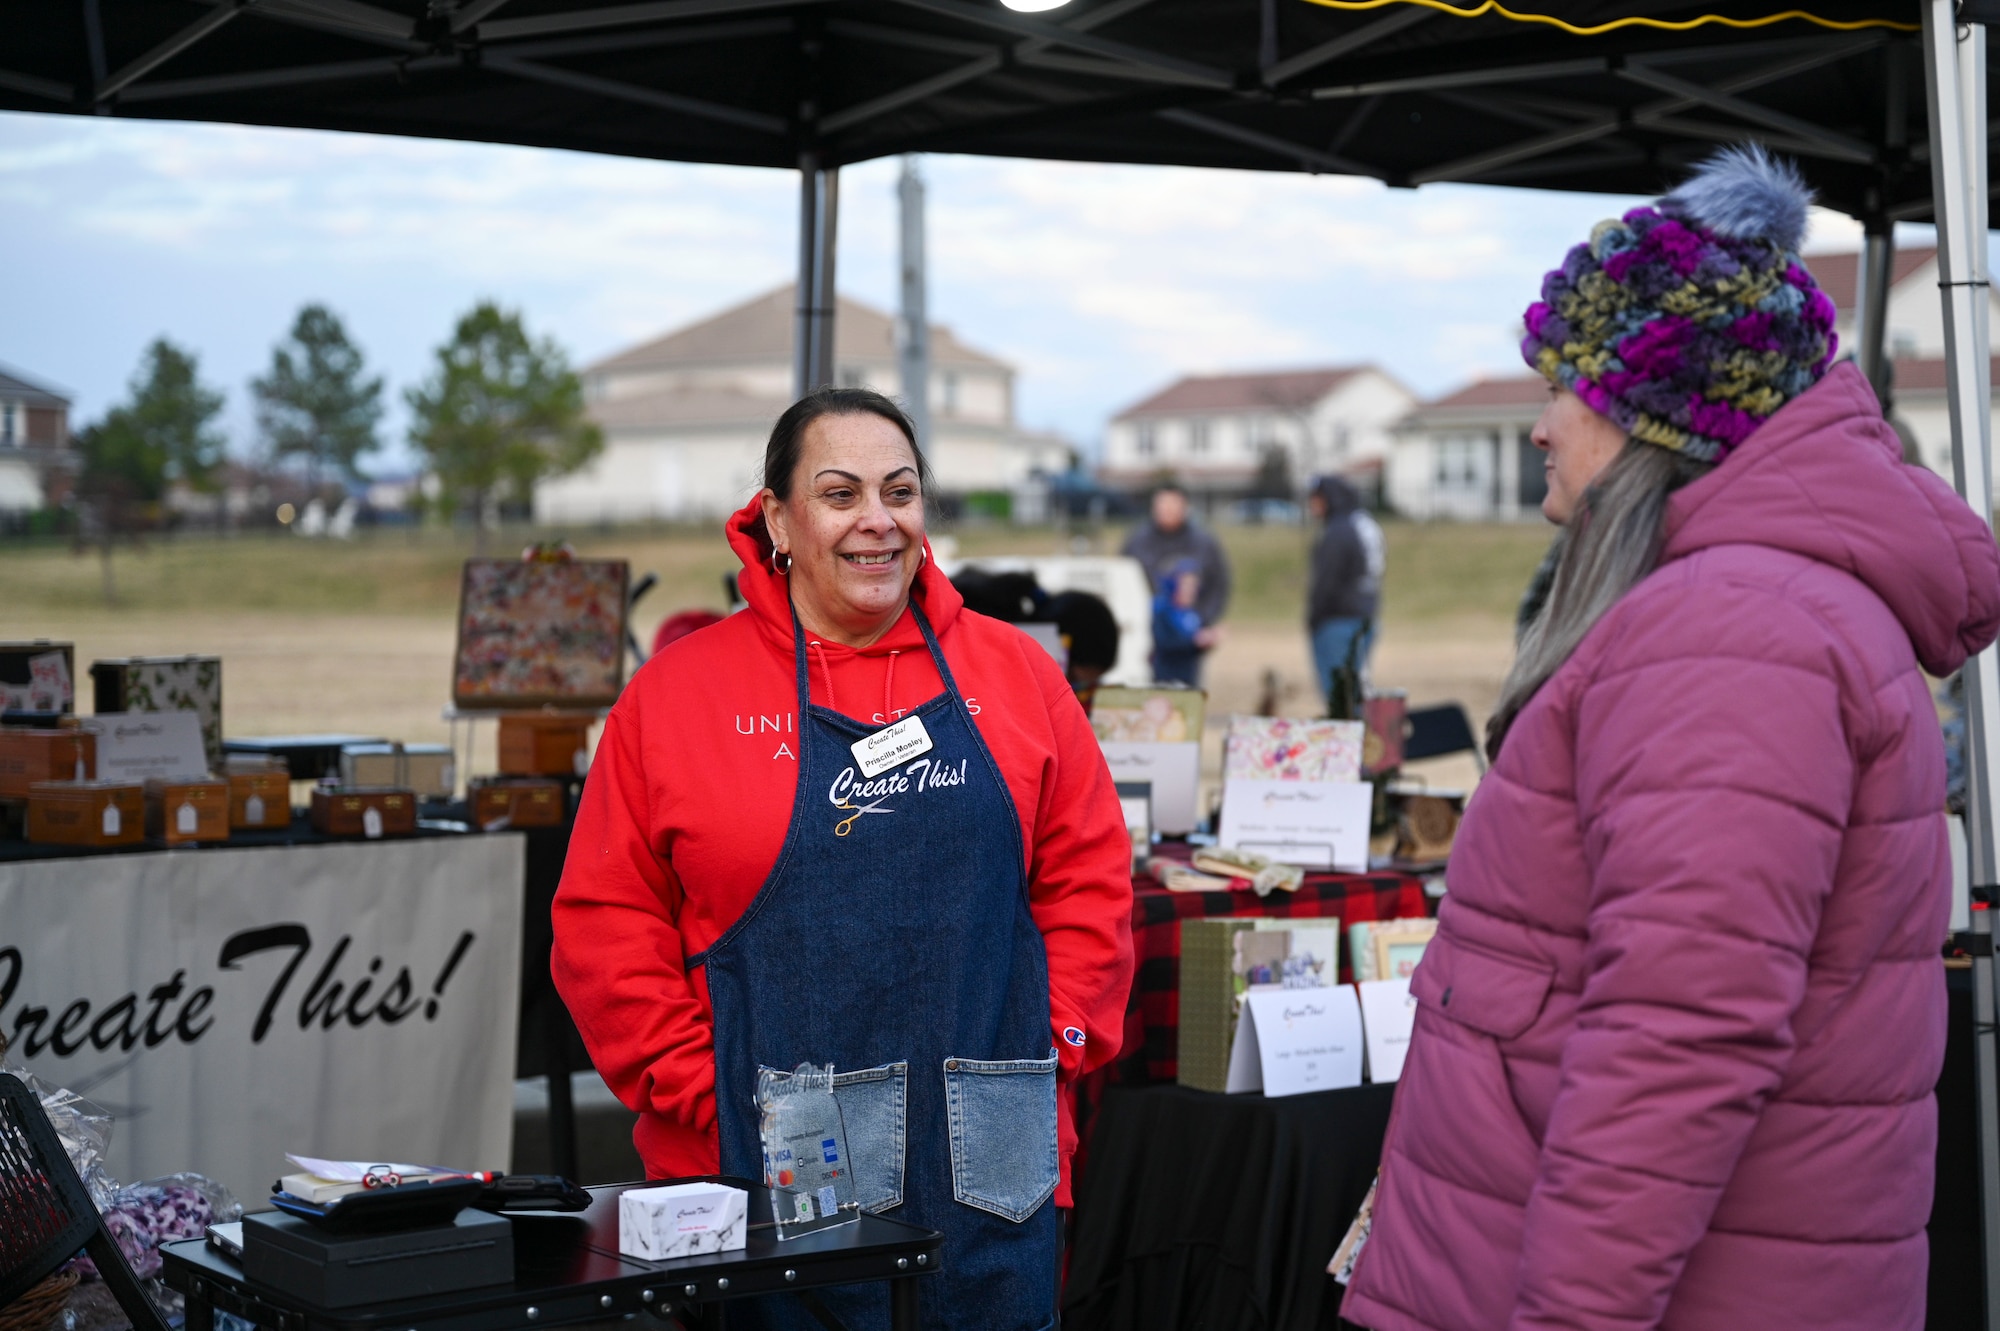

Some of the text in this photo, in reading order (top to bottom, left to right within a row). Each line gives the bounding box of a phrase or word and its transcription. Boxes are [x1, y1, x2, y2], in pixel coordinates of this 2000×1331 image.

[736, 712, 792, 735] UNI
[867, 724, 906, 750] Create This!
[865, 737, 923, 768] Priscilla Mosley
[879, 759, 895, 769] Owner
[898, 749, 917, 761] Veteran
[829, 759, 967, 805] Create This!
[218, 922, 476, 1044] This!
[774, 1149, 792, 1163] VISA
